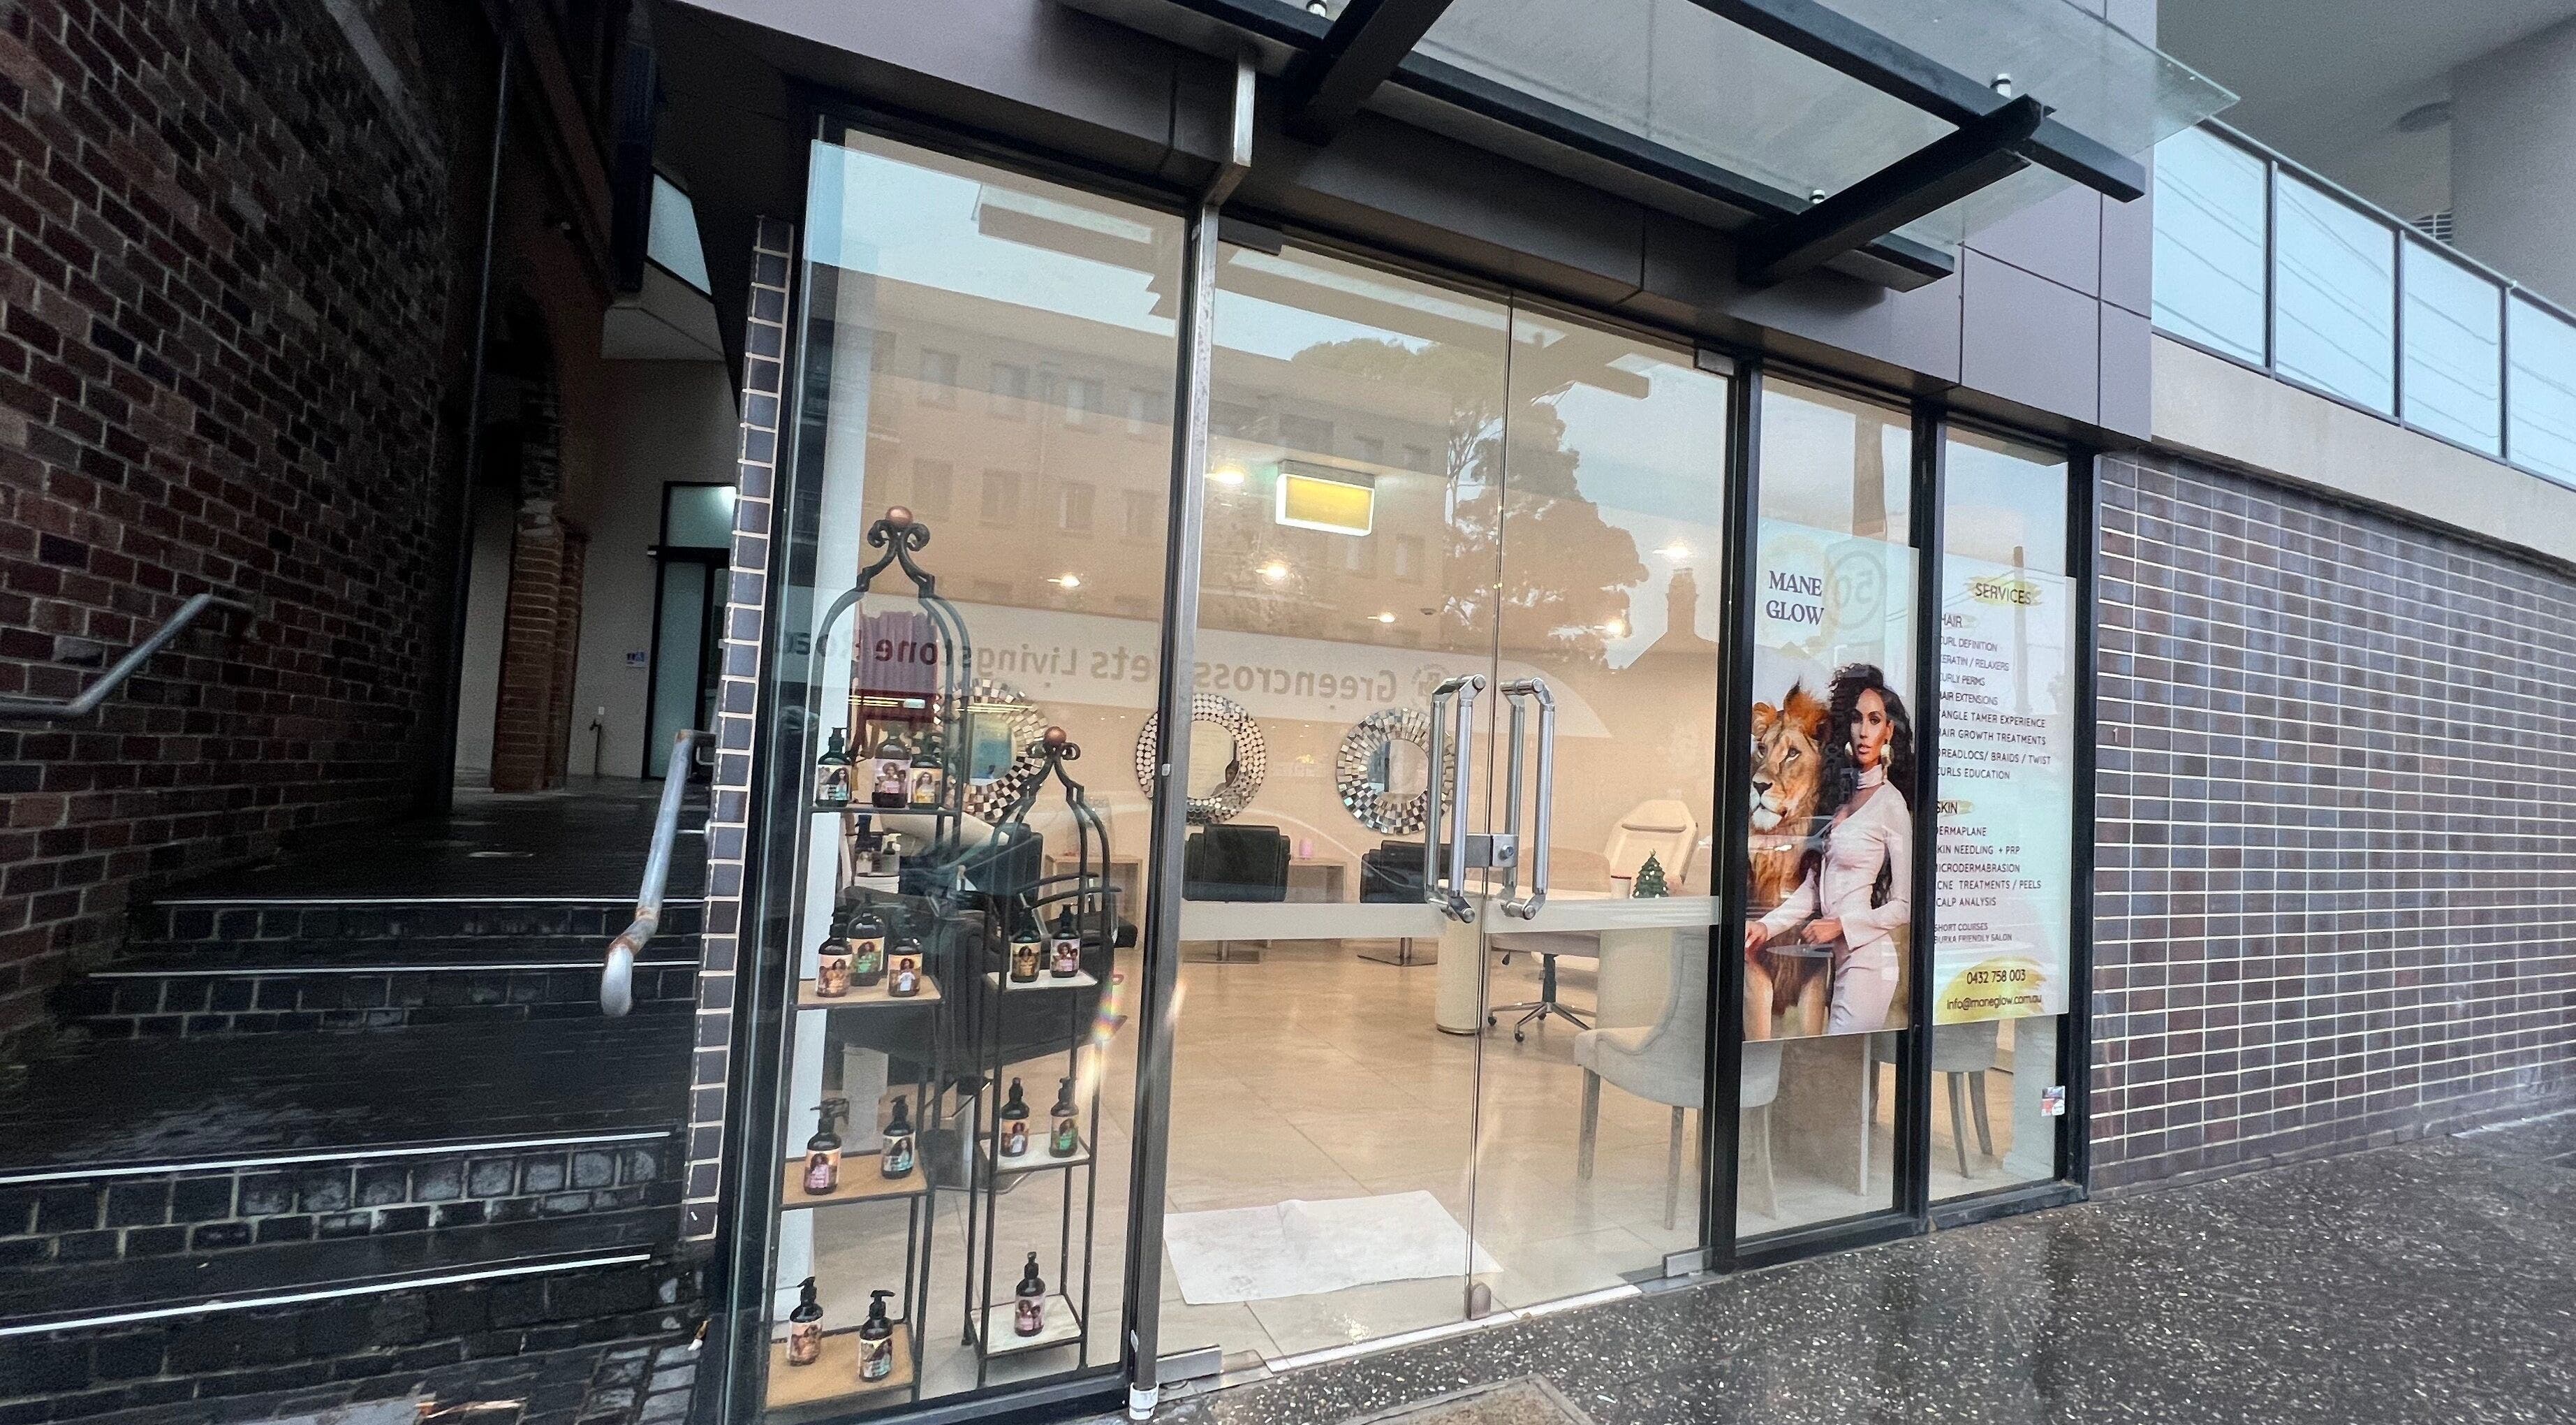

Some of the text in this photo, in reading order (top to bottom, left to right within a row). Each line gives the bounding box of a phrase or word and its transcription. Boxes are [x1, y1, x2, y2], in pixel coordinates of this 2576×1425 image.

[1769, 570, 1822, 597] MANE
[1975, 583, 2031, 605] SERVICES
[1766, 600, 1824, 625] GLOW
[1941, 613, 1962, 628] HAIR
[1958, 638, 1997, 652] DEFINITION
[1941, 655, 1968, 666] ERATIN
[1975, 659, 2009, 671] RELAXERS
[1941, 673, 1960, 683] URLY
[1941, 710, 2046, 728] ANGLE TAMER EXPERIENCE
[1958, 729, 1994, 741] GROWTH
[1996, 732, 2046, 745] TREATMENTS
[1991, 752, 2019, 763] BRAIDS
[2029, 754, 2051, 764] TWIST
[1964, 768, 2010, 780] EDUCATION
[1937, 801, 1958, 814] SKIN
[1938, 826, 1987, 836] ERMAPLANE
[1937, 845, 1951, 854] KIN
[1954, 845, 1994, 854] NEEDLING
[2005, 846, 2021, 855] PRP
[1936, 863, 2020, 873] ICRODERMABRASION
[1937, 881, 1953, 890] CNE
[1959, 880, 2010, 890] TREATMENTS
[2019, 880, 2042, 889] PEELS
[1936, 898, 1996, 907] CALP ANALYSIS
[1958, 923, 1989, 931] COURSES
[1966, 969, 2026, 984] 0432 758 003
